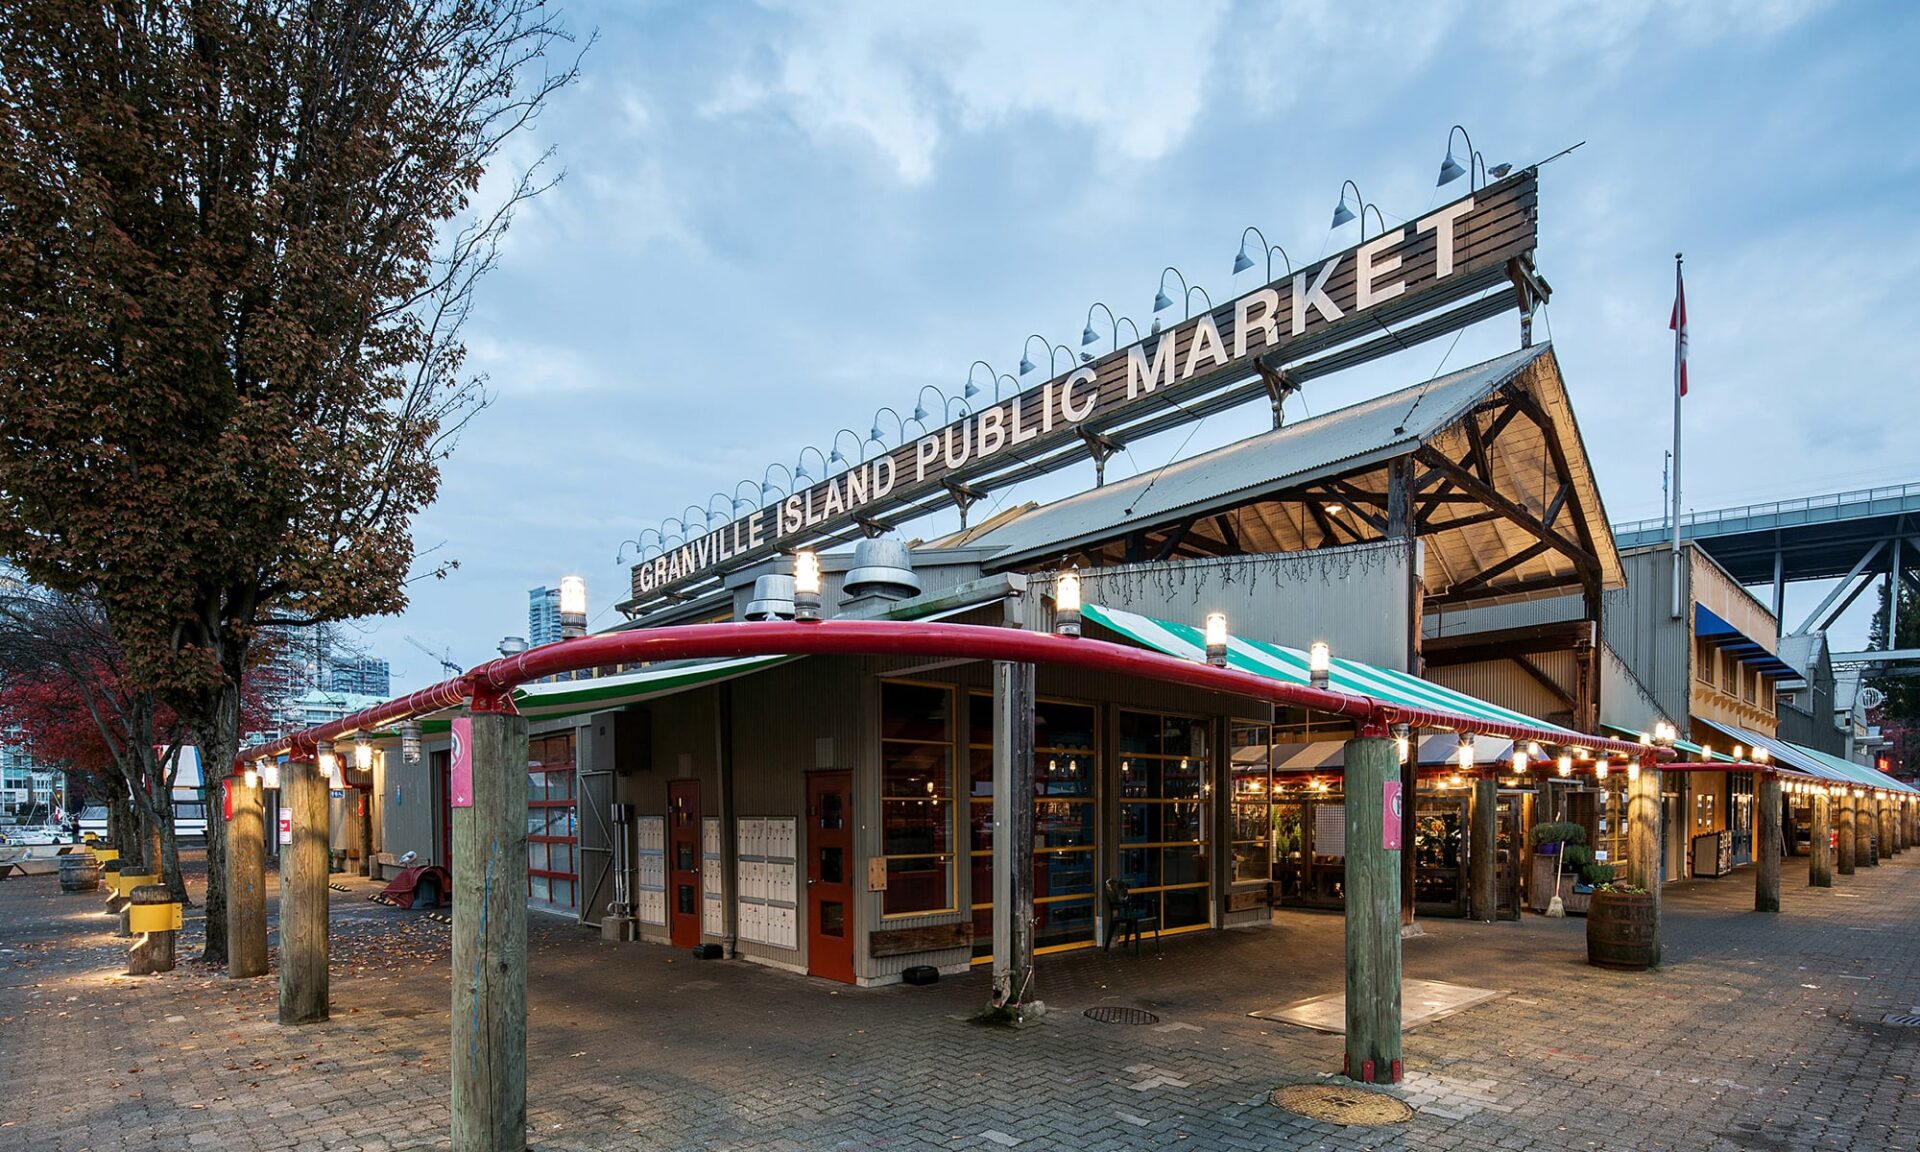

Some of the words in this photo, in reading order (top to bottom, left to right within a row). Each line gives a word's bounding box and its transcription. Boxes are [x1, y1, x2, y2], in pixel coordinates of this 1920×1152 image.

[640, 510, 764, 592] GRANVILLE
[777, 455, 896, 538] ISLAND
[916, 367, 1097, 483] PUBLIC
[1127, 197, 1475, 400] MARKET
